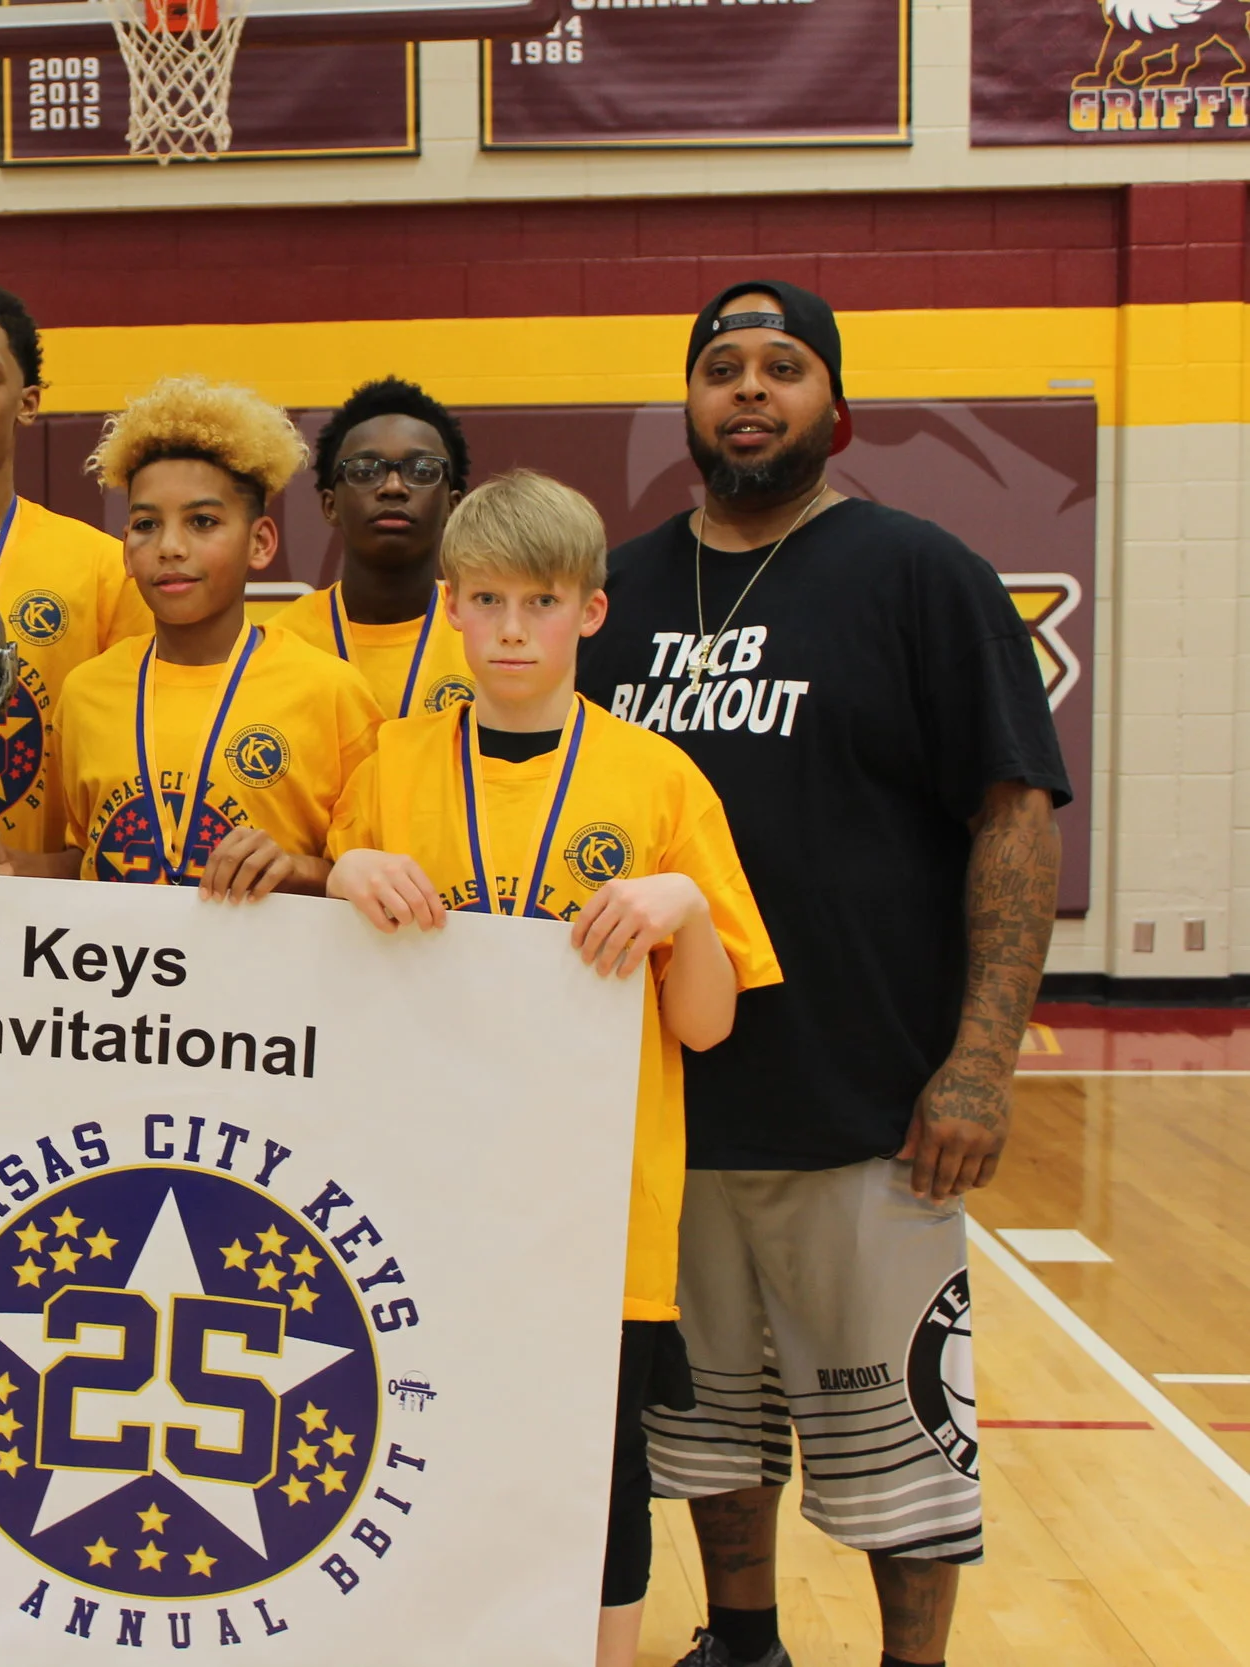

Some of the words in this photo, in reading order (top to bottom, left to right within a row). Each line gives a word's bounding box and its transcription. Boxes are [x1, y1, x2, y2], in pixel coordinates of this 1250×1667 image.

[29, 57, 100, 81] 2009
[510, 40, 583, 65] 1986
[29, 82, 100, 106] 2013
[29, 106, 100, 131] 2015
[649, 625, 768, 678] TKCB
[611, 678, 810, 737] BLACKOUT
[23, 925, 188, 998] Keys
[144, 1113, 292, 1188] CITY
[299, 1179, 420, 1334] KEYS
[34, 1283, 287, 1490] 25
[817, 1363, 891, 1391] BLACKOUT
[934, 1418, 979, 1476] BL
[19, 1579, 288, 1650] ANNUAL
[319, 1442, 427, 1595] BBIT
